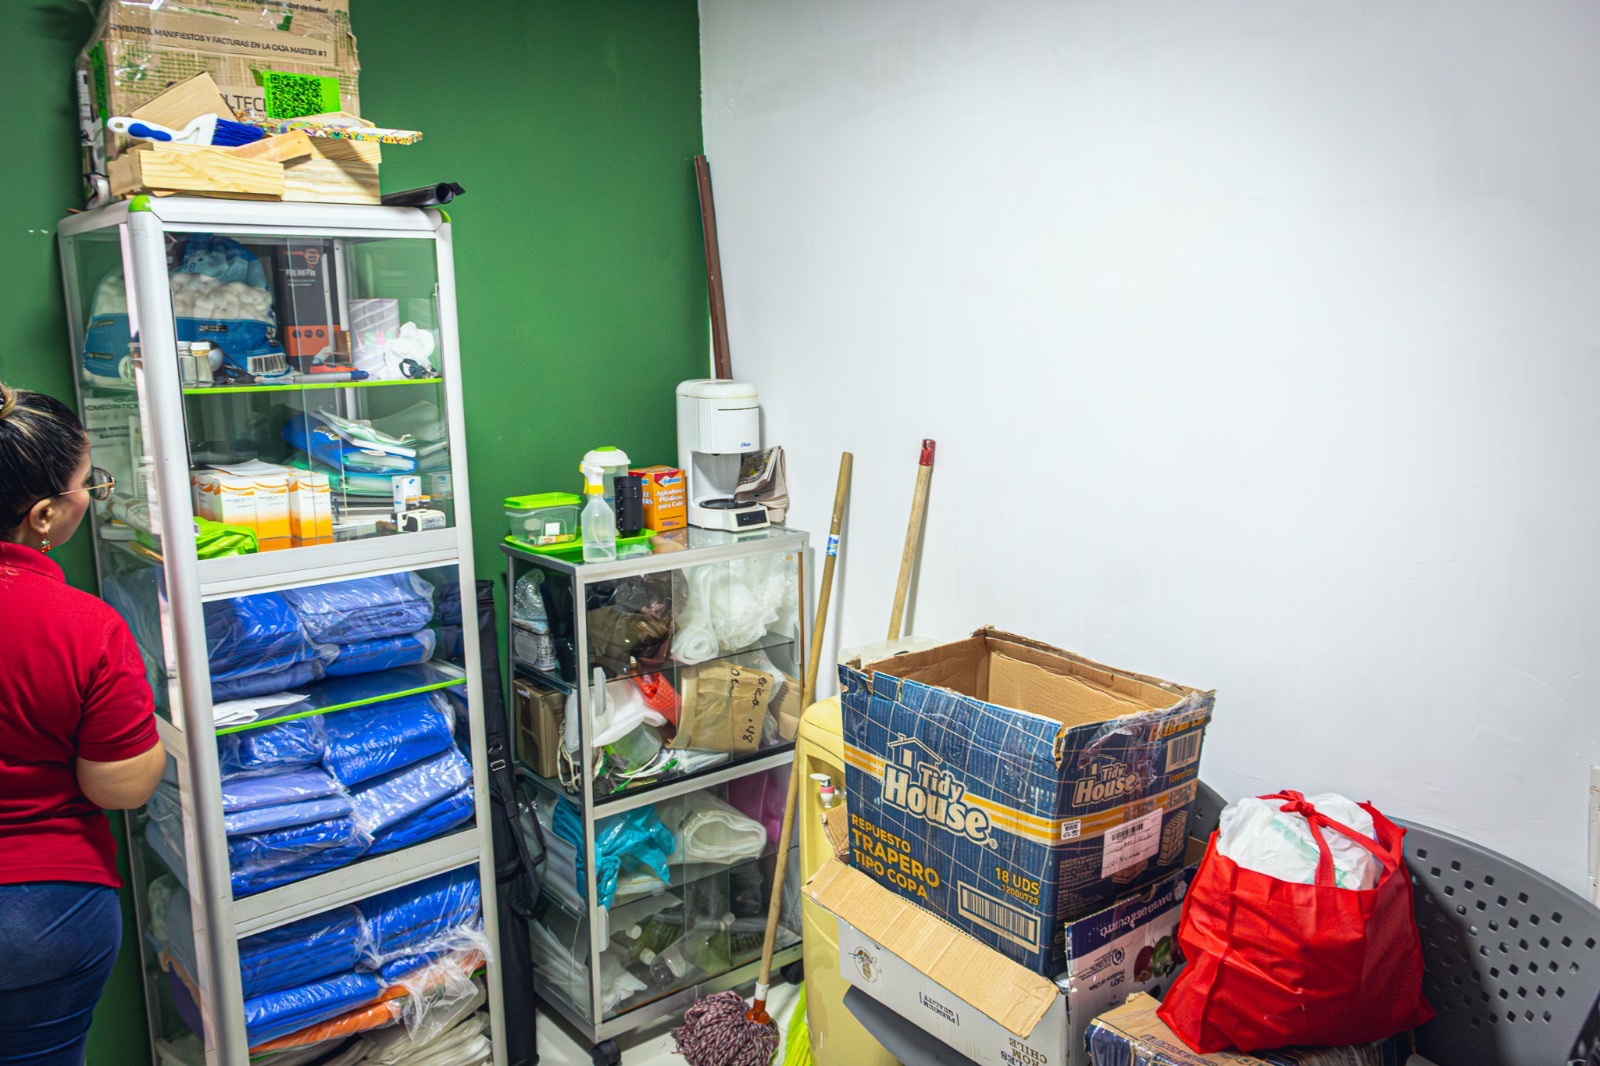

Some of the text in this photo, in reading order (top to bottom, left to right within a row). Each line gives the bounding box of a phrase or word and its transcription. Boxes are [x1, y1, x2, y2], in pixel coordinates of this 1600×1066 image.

[154, 29, 205, 42] MANIFIESTOS
[206, 35, 211, 43] Y
[212, 36, 249, 48] FACTURAS
[262, 43, 271, 51] LA
[272, 44, 289, 53] CAJA
[290, 46, 318, 57] MASTER
[658, 502, 672, 511] para
[918, 767, 964, 804] Tidy
[1101, 761, 1127, 782] Tidy
[883, 764, 991, 842] House
[1075, 772, 1138, 806] House
[851, 813, 911, 854] REPUESTO
[851, 828, 941, 889] TRAPERO
[853, 849, 929, 901] TIPO COPA
[995, 867, 1041, 896] 18 UDS
[1001, 883, 1039, 907] 12000723
[923, 994, 954, 1016] QUALITY
[923, 1000, 956, 1024] PREMIUM
[1008, 1037, 1048, 1064] CHILE
